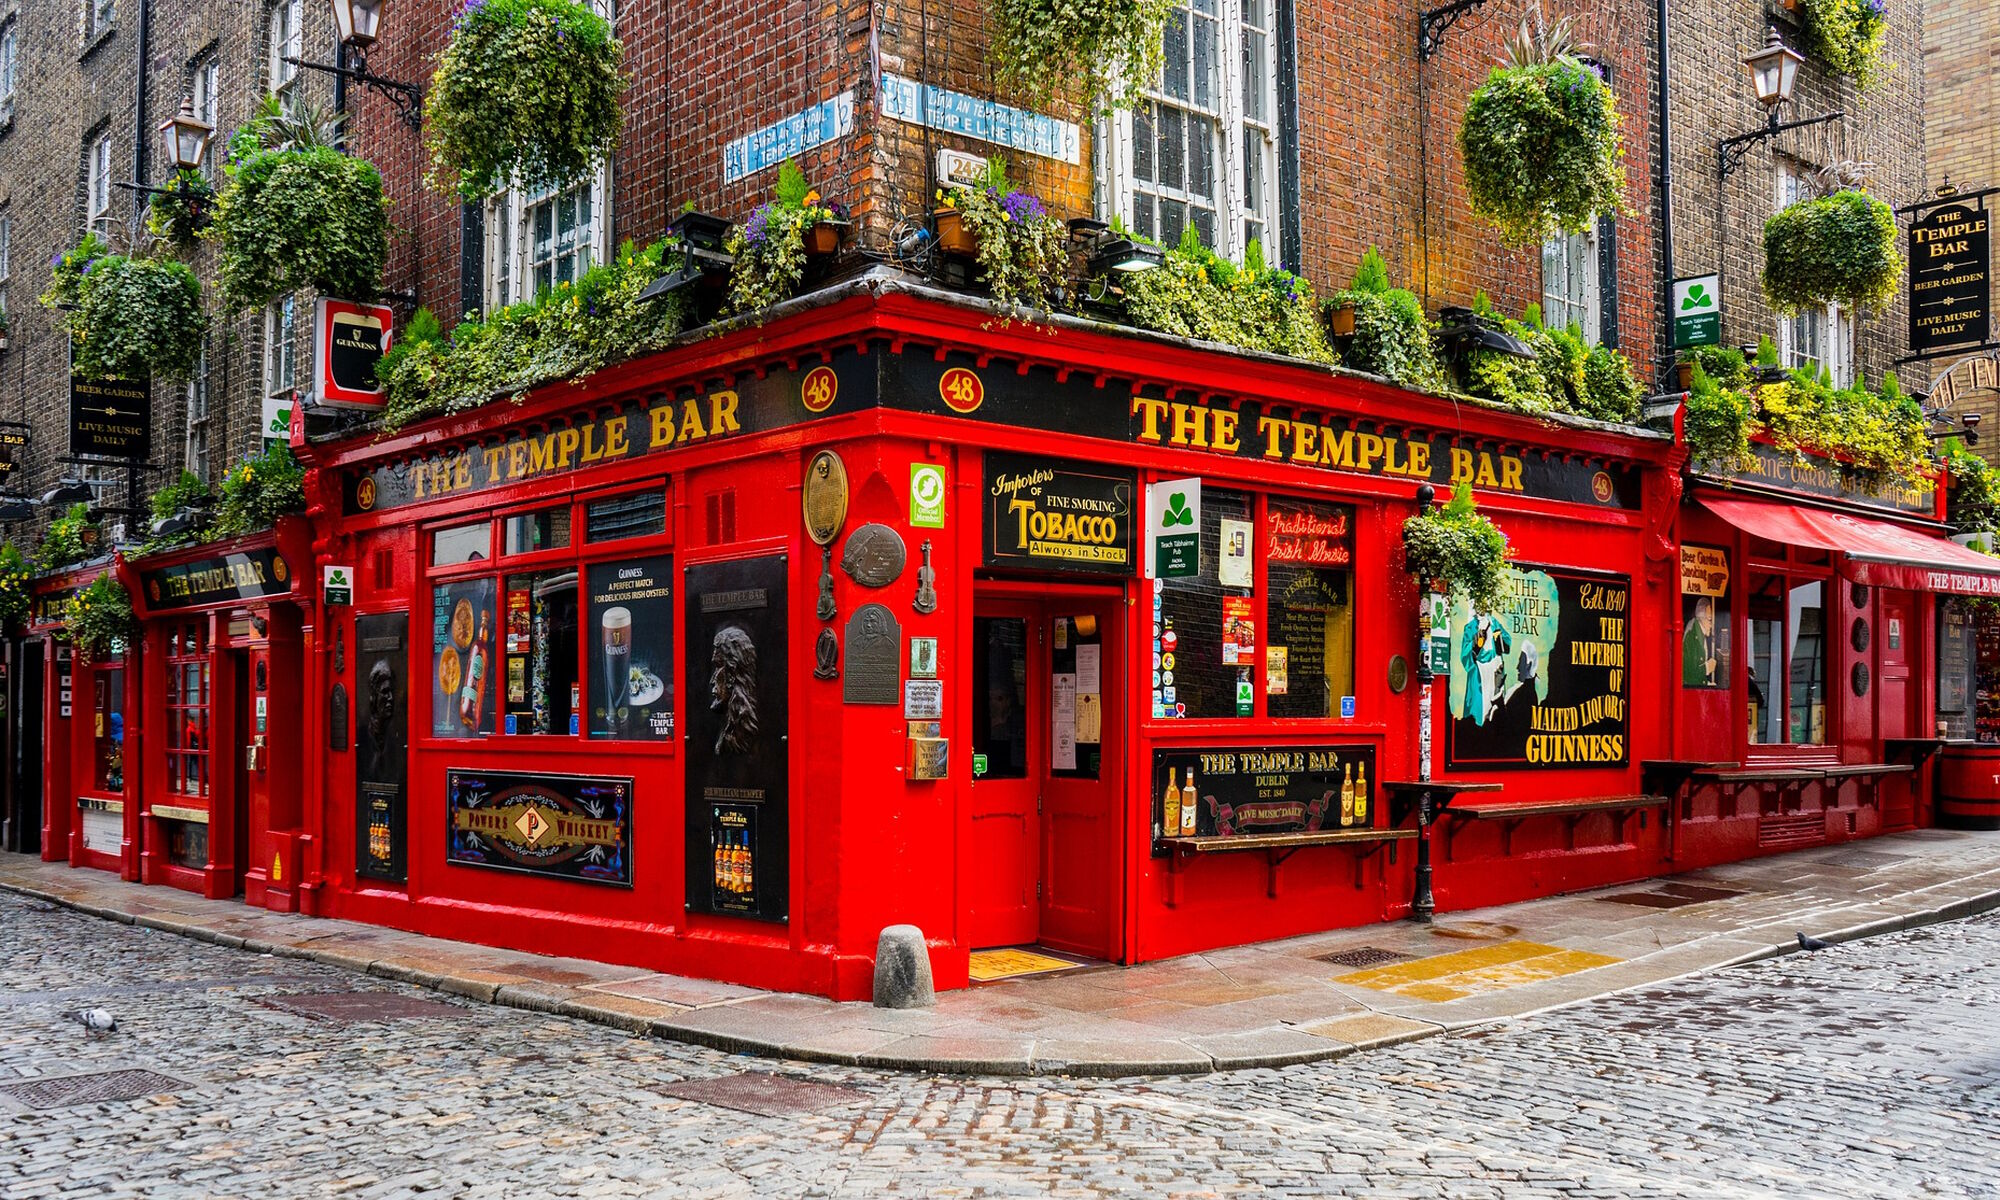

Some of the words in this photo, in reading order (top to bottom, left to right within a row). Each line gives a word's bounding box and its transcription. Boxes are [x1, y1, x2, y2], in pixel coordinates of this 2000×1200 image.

[840, 104, 849, 124] 2
[955, 99, 971, 114] AN
[926, 109, 973, 133] TEMPLE
[1012, 131, 1053, 150] SOUTH
[760, 138, 797, 166] TEMPLE
[1936, 211, 1961, 223] THE
[1912, 220, 1987, 243] TEMPLE
[1930, 240, 1969, 257] BAR
[1914, 280, 1940, 291] BEER
[1942, 272, 1984, 286] GARDEN
[1917, 315, 1942, 326] LIVE
[1944, 309, 1981, 322] MUSIC
[1931, 323, 1965, 336] DAILY
[336, 338, 377, 350] GUINNESS
[75, 384, 103, 395] BEER
[103, 387, 145, 399] GARDEN
[806, 374, 831, 405] 48
[946, 373, 975, 402] 48
[78, 422, 105, 433] LIVE
[106, 424, 143, 436] MUSIC
[4, 435, 25, 445] BAR
[93, 434, 128, 446] DAILY
[411, 450, 474, 498] THE
[483, 415, 631, 484] TEMPLE
[648, 389, 741, 448] BAR
[1131, 396, 1241, 456] THE
[1257, 416, 1433, 481] TEMPLE
[1448, 447, 1525, 492] BAR
[991, 467, 1054, 499] Importers
[1030, 486, 1042, 496] OF
[1595, 476, 1608, 496] 48
[359, 482, 373, 505] 48
[1046, 495, 1070, 509] FINE
[1071, 498, 1117, 513] SMOKING
[1008, 498, 1117, 549] TOBACCO
[1268, 511, 1346, 535] Traditional
[1031, 542, 1073, 556] Always
[1078, 547, 1089, 557] in
[1092, 546, 1126, 561] Stock
[1267, 535, 1303, 560] Irish
[1308, 540, 1350, 563] Music
[1682, 549, 1696, 564] Beer
[1697, 551, 1720, 568] Garden
[166, 574, 191, 598] THE
[190, 565, 237, 594] TEMPLE
[237, 560, 266, 587] BAR
[618, 567, 643, 579] GUINNESS
[1681, 563, 1707, 582] Smoking
[1927, 572, 1949, 590] THE
[1951, 574, 1989, 592] TEMPLE
[608, 583, 614, 591] A
[613, 580, 635, 591] PERFECT
[635, 578, 653, 589] MATCH
[1283, 576, 1319, 598] TEMPLE
[1321, 581, 1339, 603] BAR
[1513, 578, 1539, 598] THE
[1687, 579, 1702, 593] Area
[594, 594, 606, 604] FOR
[605, 591, 632, 602] DELICIOUS
[632, 590, 646, 600] IRISH
[645, 587, 669, 598] OYSTERS
[702, 593, 717, 606] THE
[718, 591, 748, 604] TEMPLE
[748, 588, 766, 600] BAR
[1605, 589, 1626, 612] 1840
[1513, 616, 1539, 637] BAR
[1599, 617, 1624, 641] THE
[1571, 640, 1625, 668] EMPEROR
[1609, 668, 1624, 693] OF
[649, 718, 674, 727] TEMPLE
[1530, 705, 1579, 732] MALTED
[1580, 694, 1626, 727] LIQUORS
[655, 727, 669, 735] BAR
[1525, 734, 1624, 763] GUINNESS
[1200, 753, 1237, 775] THE
[1240, 752, 1305, 774] TEMPLE
[1308, 751, 1340, 773] BAR
[1255, 775, 1290, 787] DUBLIN
[1258, 789, 1272, 798] EST.
[1273, 789, 1286, 798] 1840
[1238, 809, 1257, 820] LIVE
[1258, 808, 1280, 819] MUSIC
[1281, 807, 1303, 818] DAILY
[468, 812, 508, 830] POWERS
[527, 812, 539, 837] P
[557, 819, 609, 840] WHISKEY
